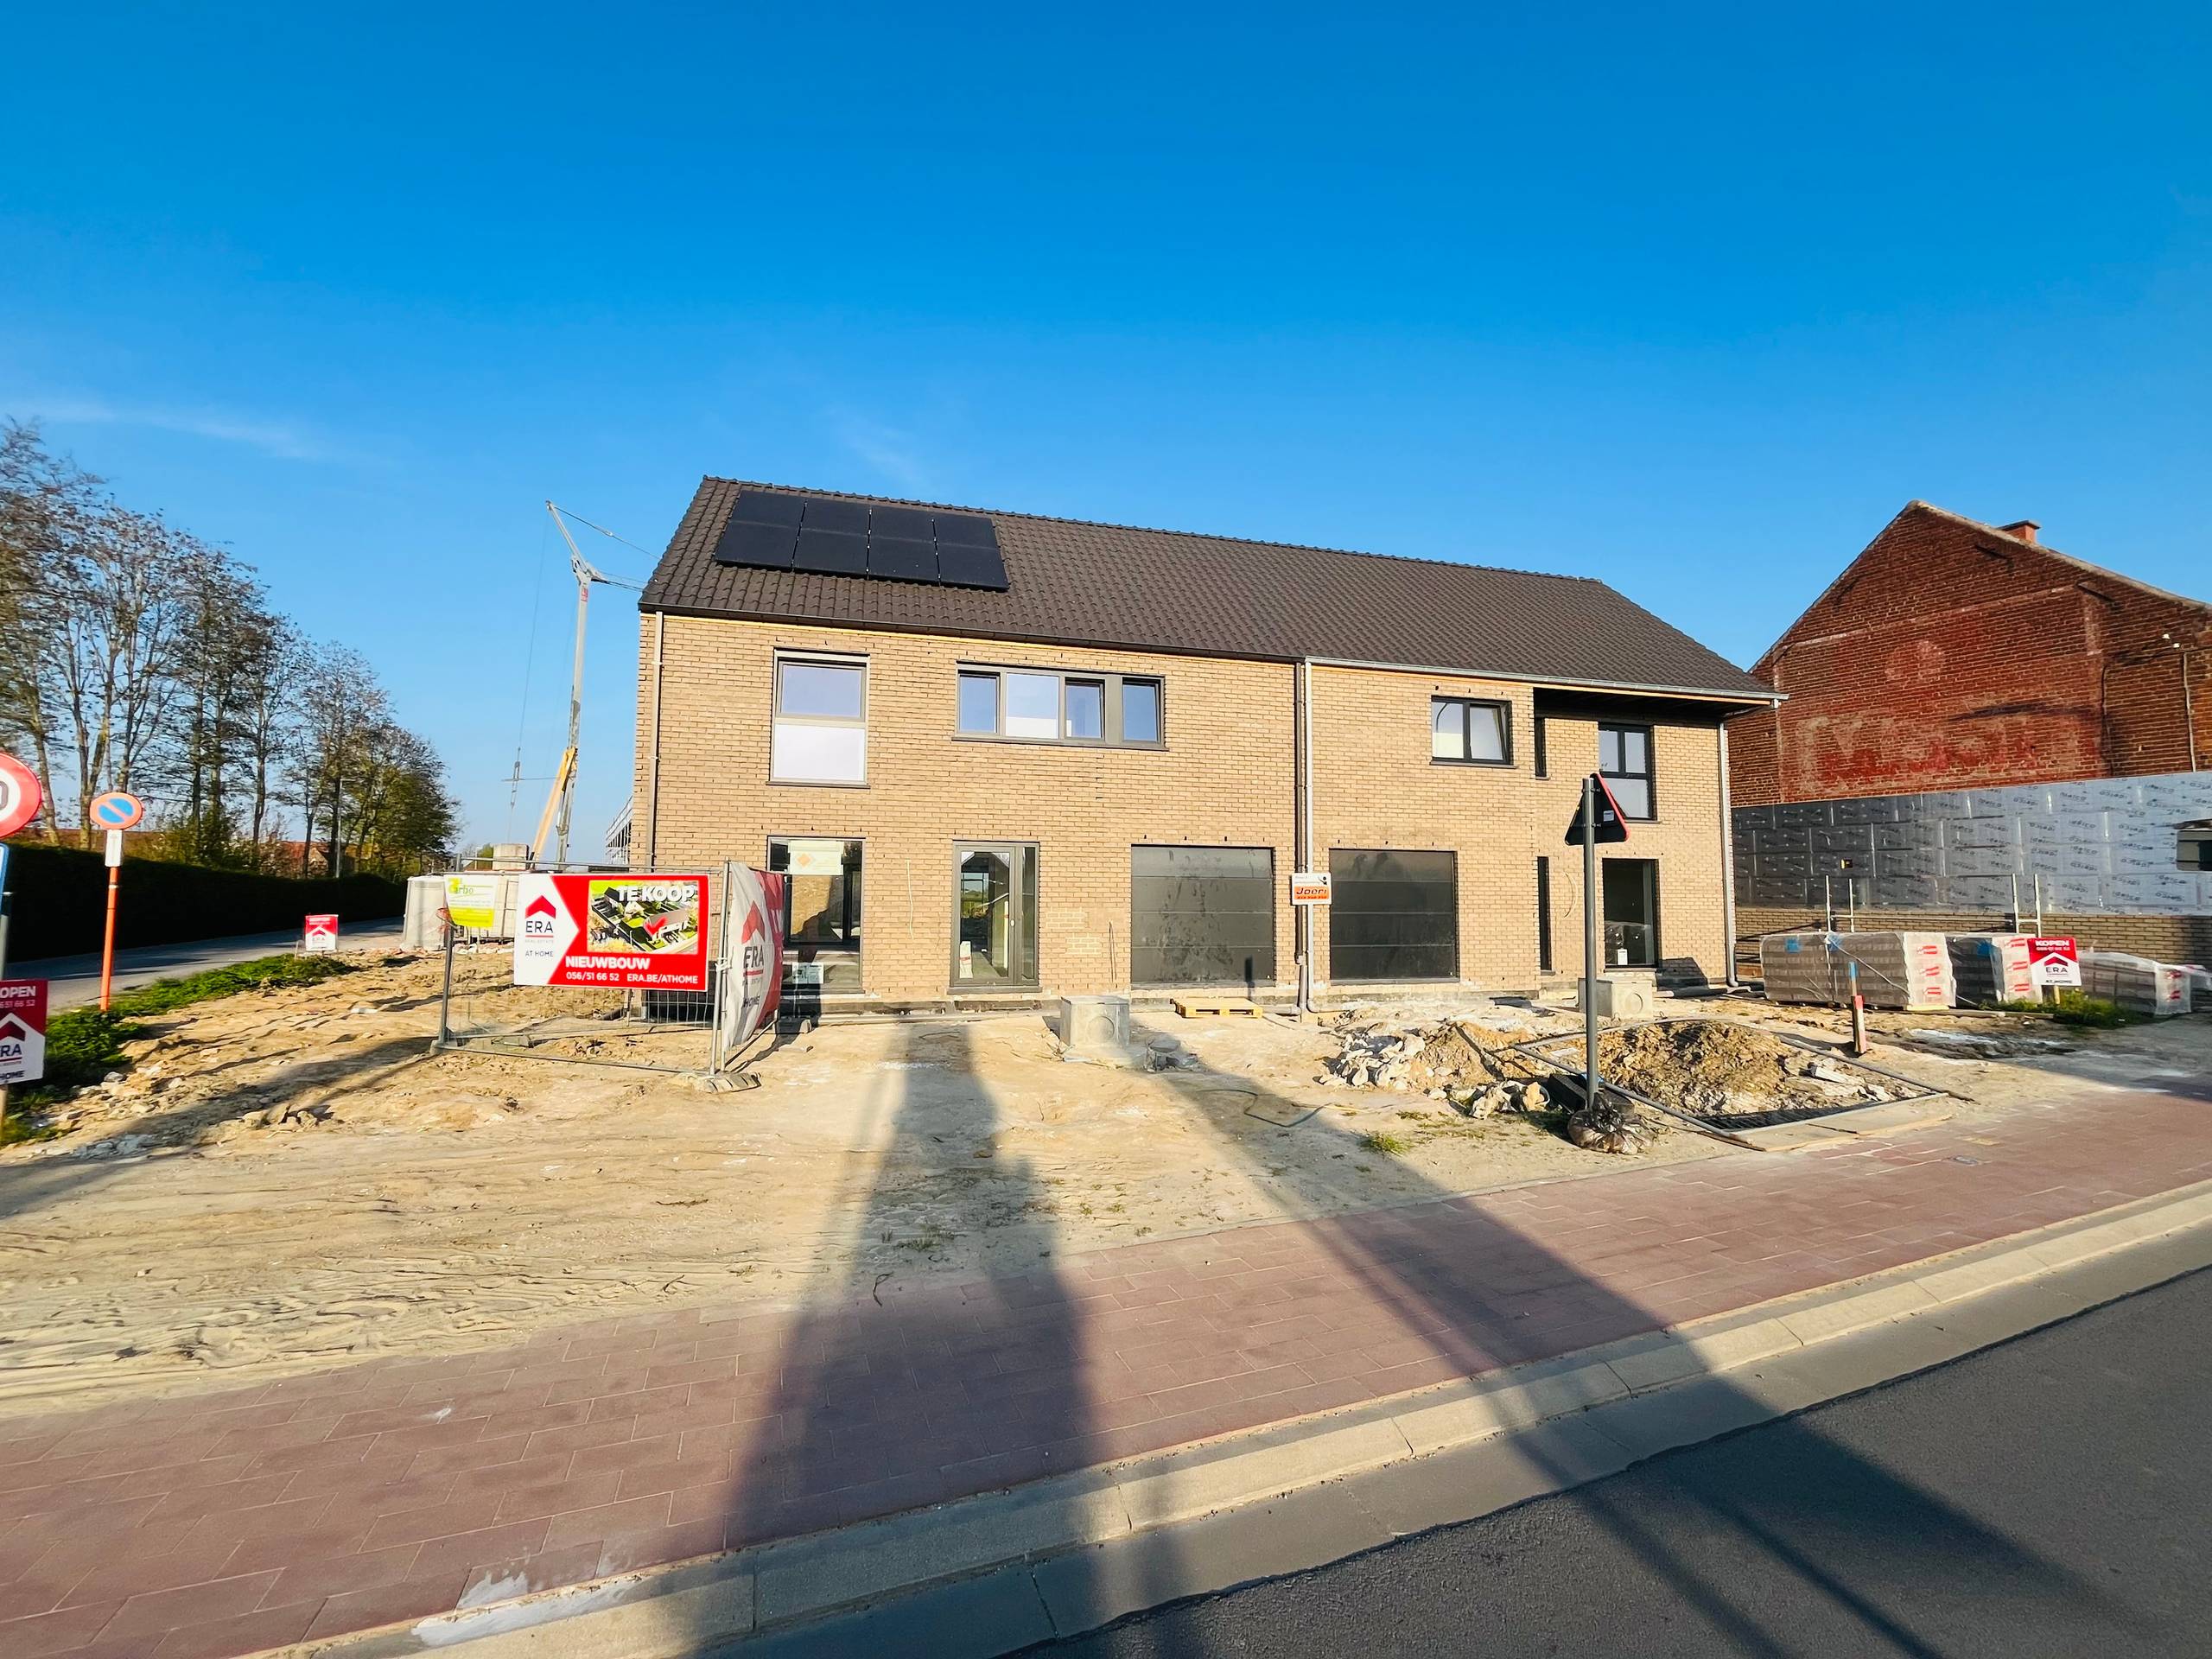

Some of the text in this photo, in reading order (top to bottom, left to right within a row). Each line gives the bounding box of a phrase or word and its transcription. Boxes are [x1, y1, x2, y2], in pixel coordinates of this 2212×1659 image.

[618, 885, 696, 903] TE KOOP
[525, 921, 553, 933] ERA
[565, 956, 651, 970] NIEUWBOUW
[566, 971, 698, 984] 056/51 66 52 ERA.BE/ATHOME
